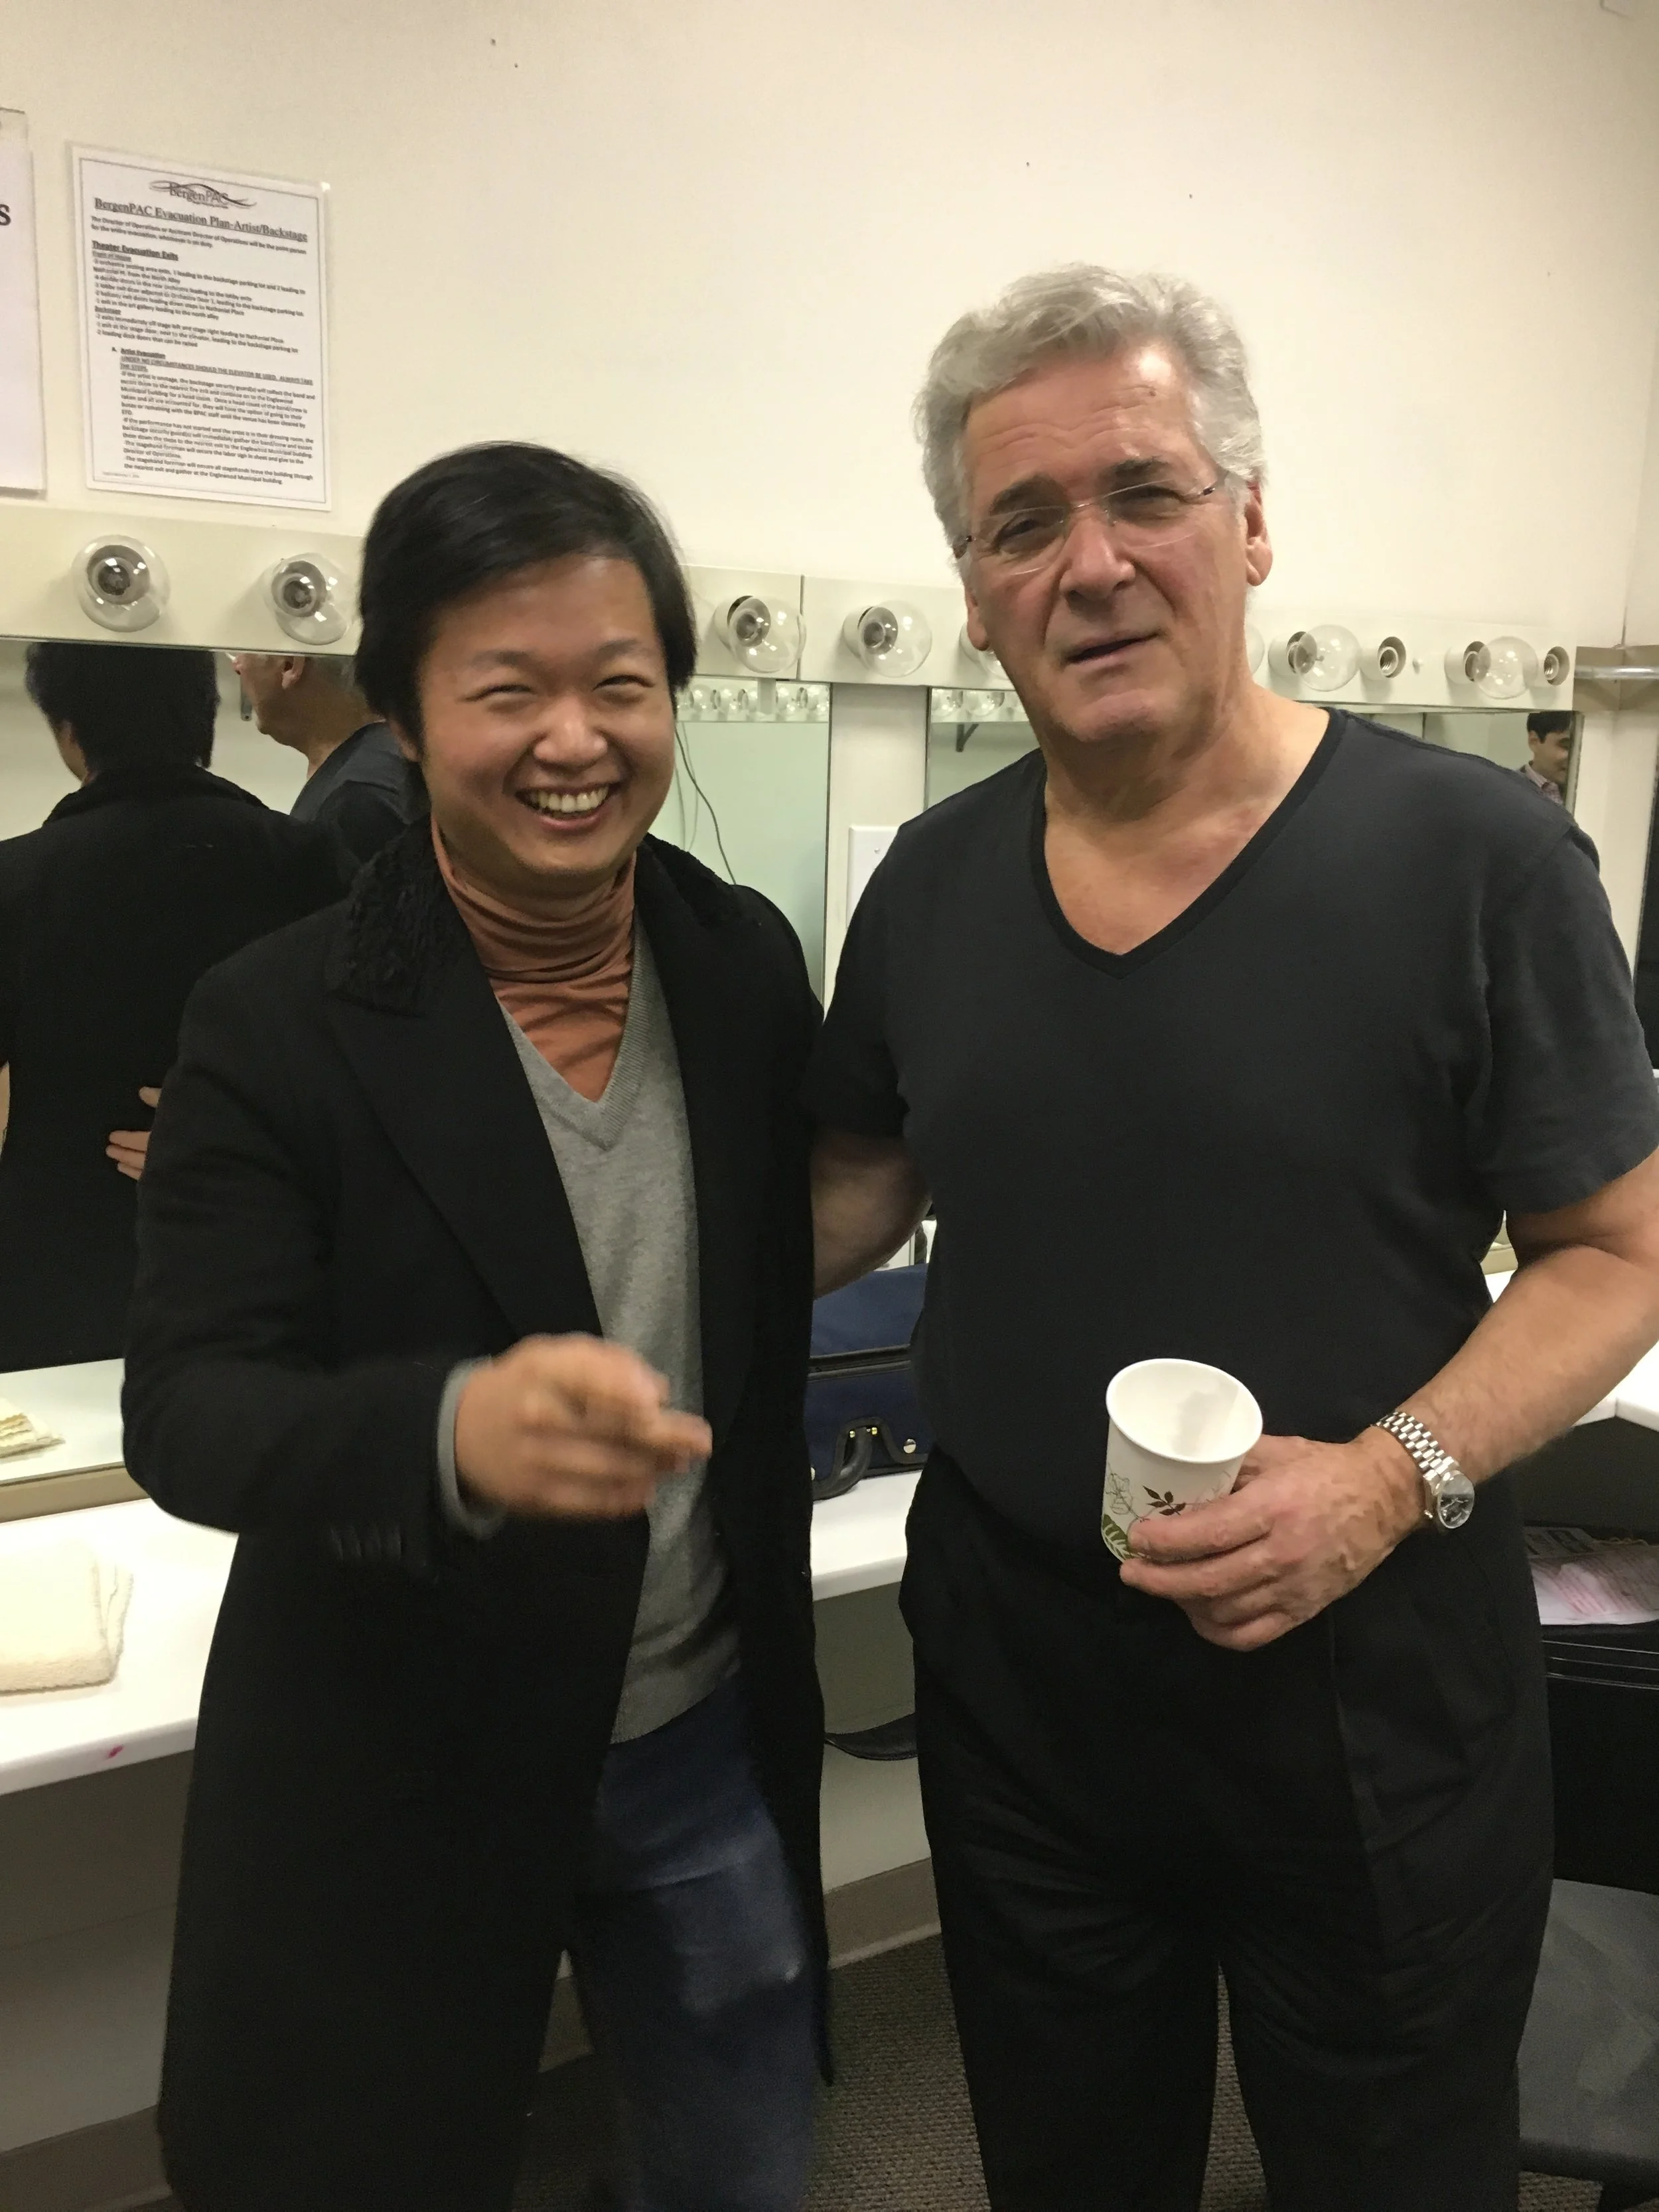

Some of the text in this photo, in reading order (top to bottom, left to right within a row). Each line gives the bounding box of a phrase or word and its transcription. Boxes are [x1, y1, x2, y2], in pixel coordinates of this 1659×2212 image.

[94, 196, 307, 242] BergenPAC Evacuation Plan-Artist/Backstage
